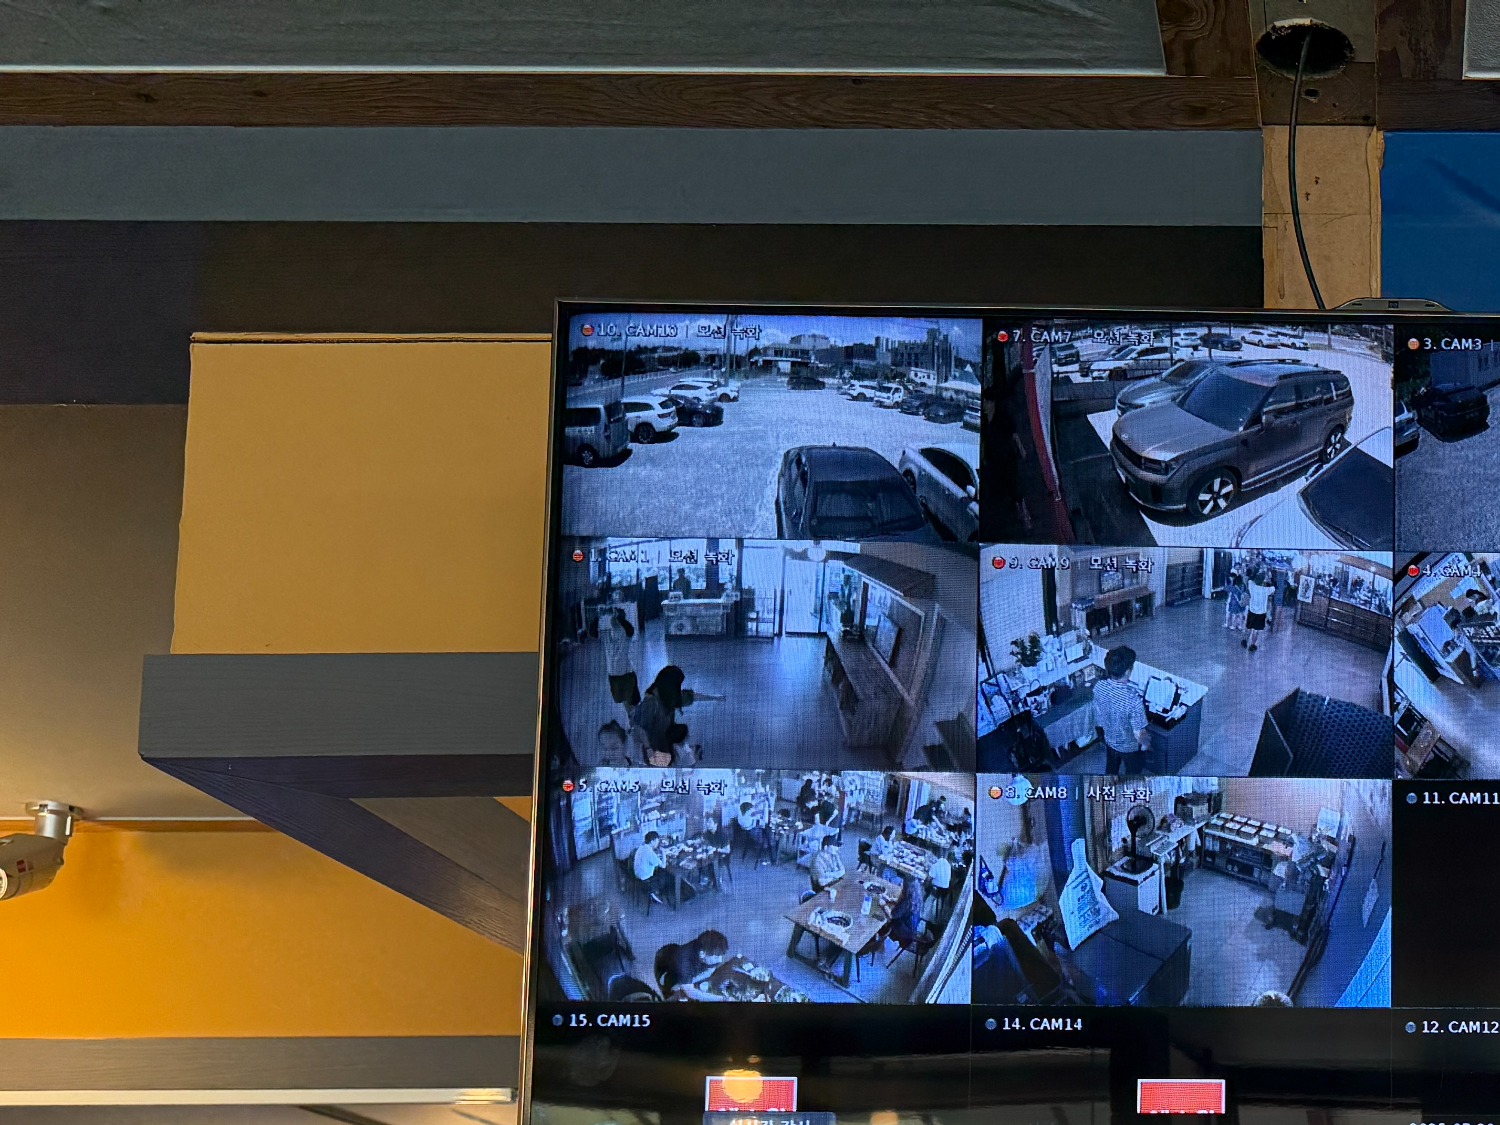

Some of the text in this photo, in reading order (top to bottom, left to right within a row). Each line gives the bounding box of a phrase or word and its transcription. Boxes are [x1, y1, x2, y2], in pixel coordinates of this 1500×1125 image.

[626, 324, 678, 337] CAM10
[1031, 331, 1071, 342] CAM7
[1424, 338, 1436, 350] 3.
[1441, 338, 1482, 350] CAM3
[1124, 557, 1153, 573] 녹화
[1025, 786, 1067, 799] CAM8
[1087, 785, 1116, 801] 사전
[1121, 785, 1151, 802] 녹화
[1422, 792, 1500, 805] 11. CAM11
[569, 1014, 651, 1027] 15. CAM15
[1003, 1018, 1082, 1031] 14. CAM14
[1422, 1021, 1499, 1034] 12. CAM12
